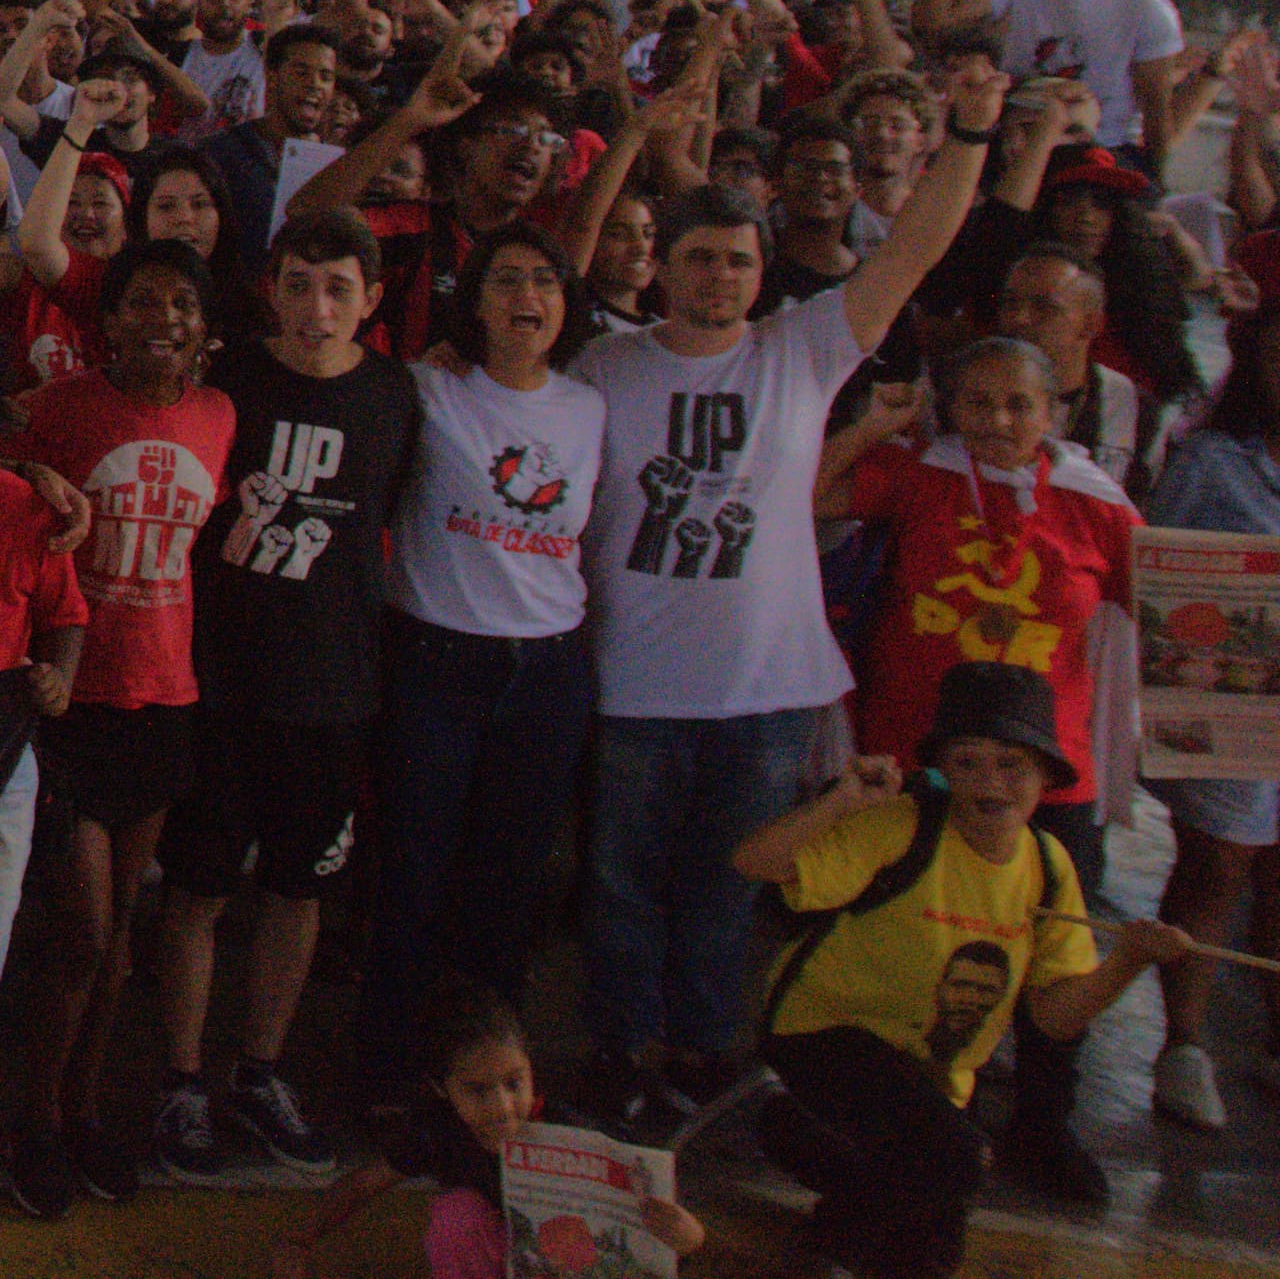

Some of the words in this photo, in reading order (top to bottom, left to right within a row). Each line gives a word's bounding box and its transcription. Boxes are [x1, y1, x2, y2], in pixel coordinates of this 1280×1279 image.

[267, 421, 344, 493] UP
[668, 392, 746, 473] UP
[93, 520, 194, 581] MLB
[912, 592, 1063, 673] PCR
